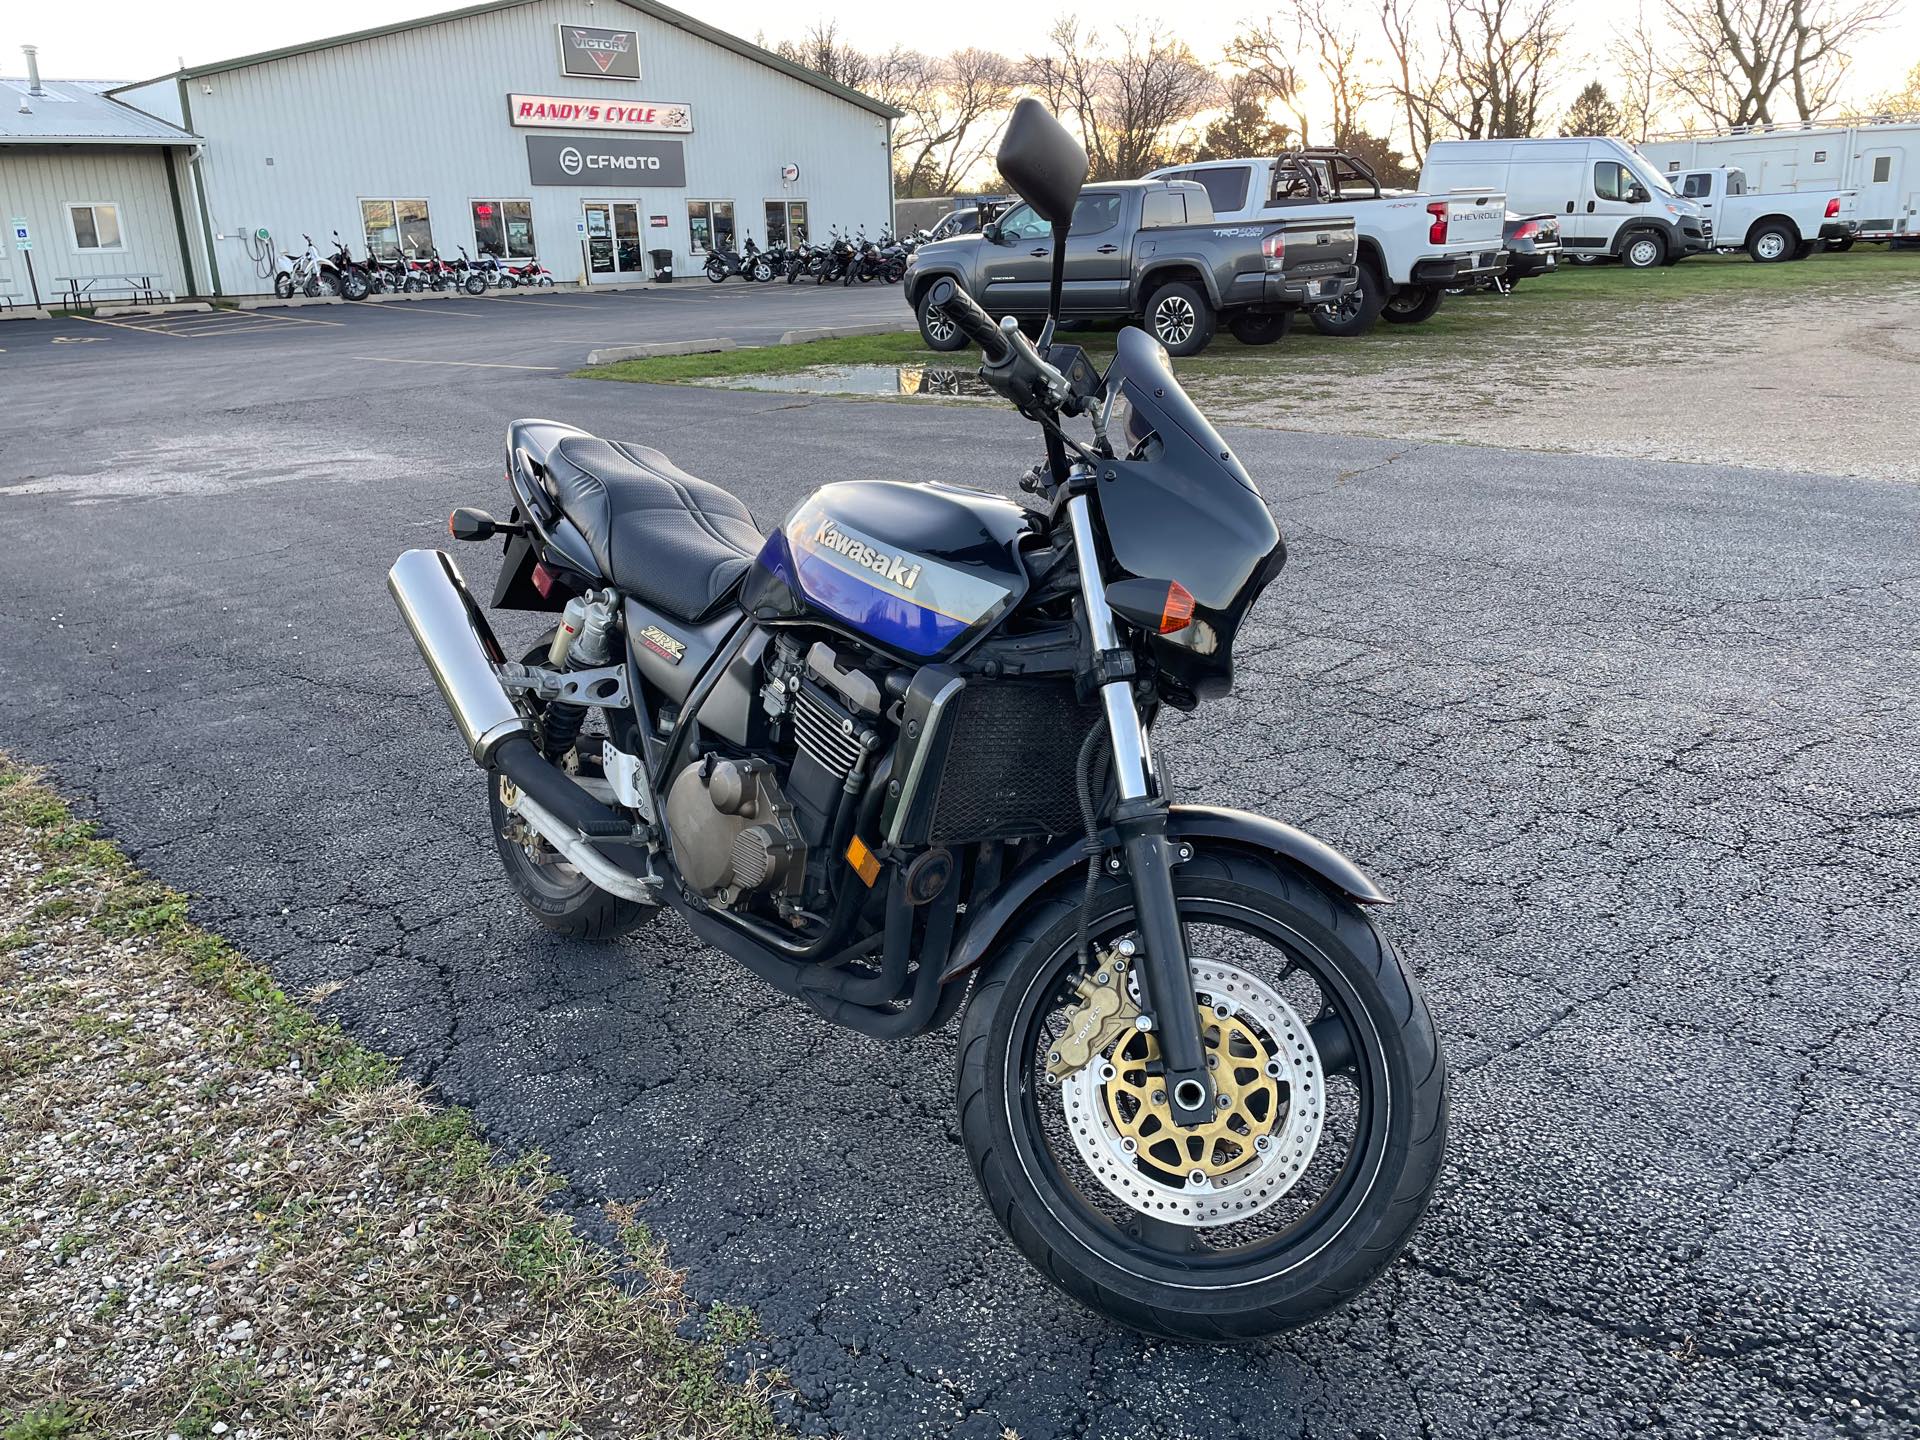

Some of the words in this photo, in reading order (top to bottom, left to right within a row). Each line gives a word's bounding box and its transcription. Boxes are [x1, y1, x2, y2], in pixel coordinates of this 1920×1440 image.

[572, 38, 628, 51] VICTORY
[519, 102, 601, 120] RANDY'S
[605, 107, 657, 123] CYCLE
[586, 155, 660, 170] CFMOTO
[1453, 211, 1502, 222] CHEVROLET
[1213, 228, 1239, 238] TRD
[815, 519, 922, 590] Kawasaki
[643, 626, 684, 656] ZRX
